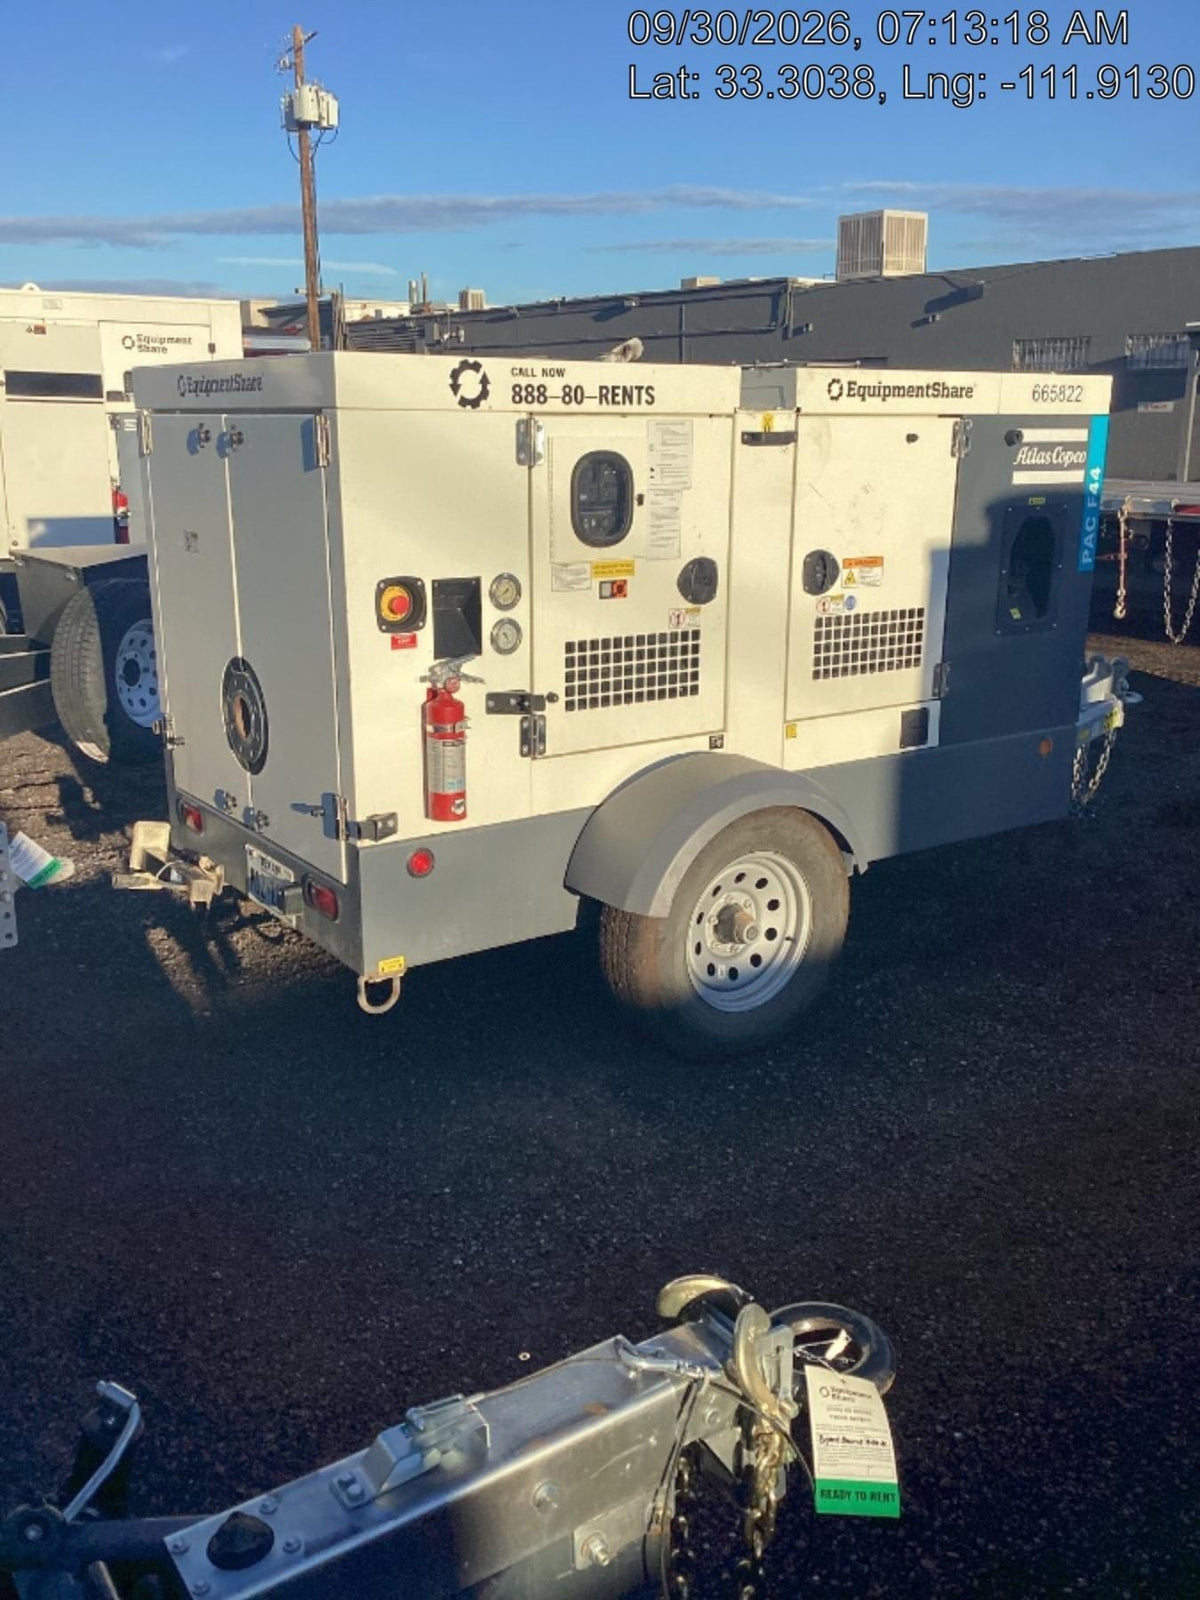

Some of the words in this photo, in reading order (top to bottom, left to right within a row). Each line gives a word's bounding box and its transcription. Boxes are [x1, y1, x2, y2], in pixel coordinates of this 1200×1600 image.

[136, 333, 192, 345] Equipment
[137, 344, 168, 354] Share
[511, 367, 537, 378] CALL
[541, 368, 566, 378] NOW
[187, 373, 263, 397] EquipmentShare
[846, 381, 974, 401] EquipmentShare
[1032, 384, 1083, 402] 665822
[511, 384, 656, 406] 888-80-RENTS
[1087, 466, 1102, 507] F44
[1081, 516, 1097, 564] PAC
[820, 1489, 851, 1501] READY
[855, 1491, 867, 1502] TO
[870, 1491, 895, 1502] RENT
